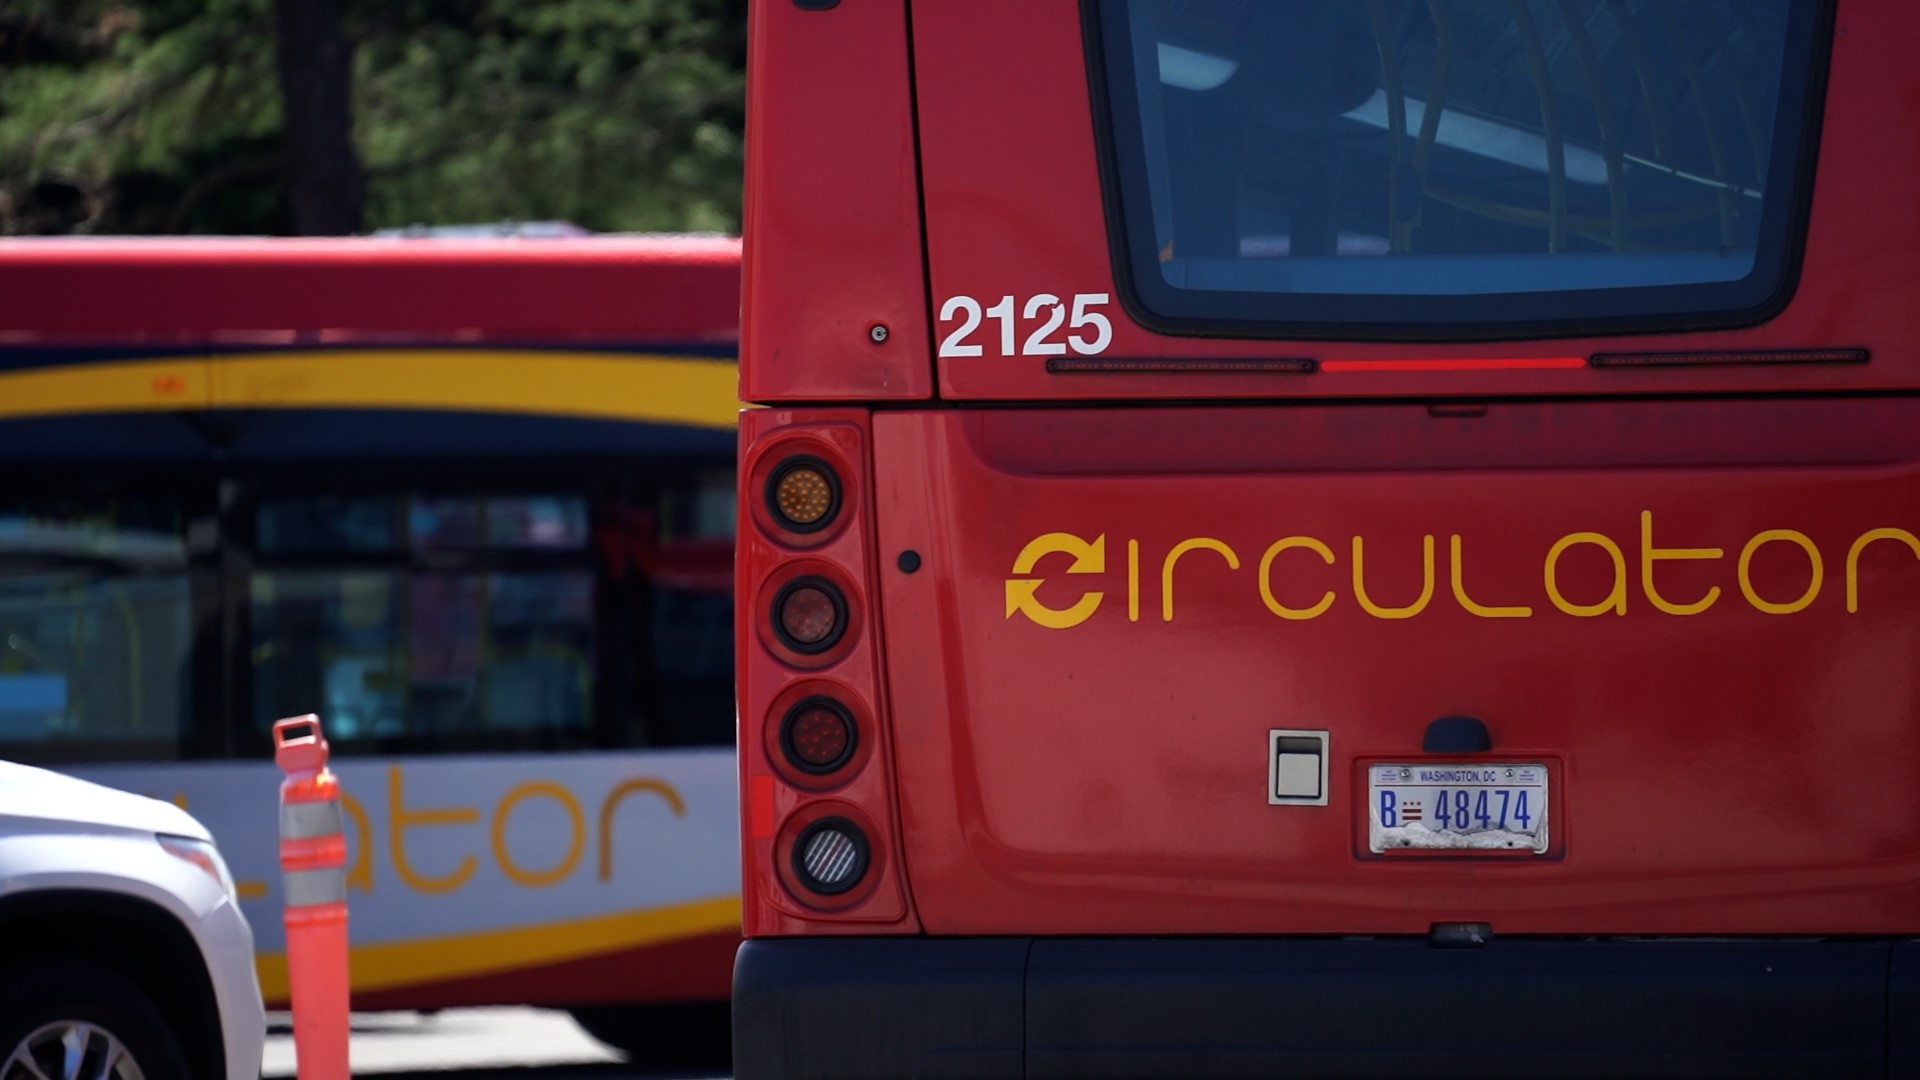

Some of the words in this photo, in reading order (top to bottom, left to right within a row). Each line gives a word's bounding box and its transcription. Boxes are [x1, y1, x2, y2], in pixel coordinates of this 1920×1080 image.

[939, 293, 1113, 357] 2125
[1420, 770, 1481, 782] WASHINGTON,
[1483, 770, 1496, 782] DC
[1380, 790, 1397, 828] B
[1434, 790, 1531, 830] 48474
